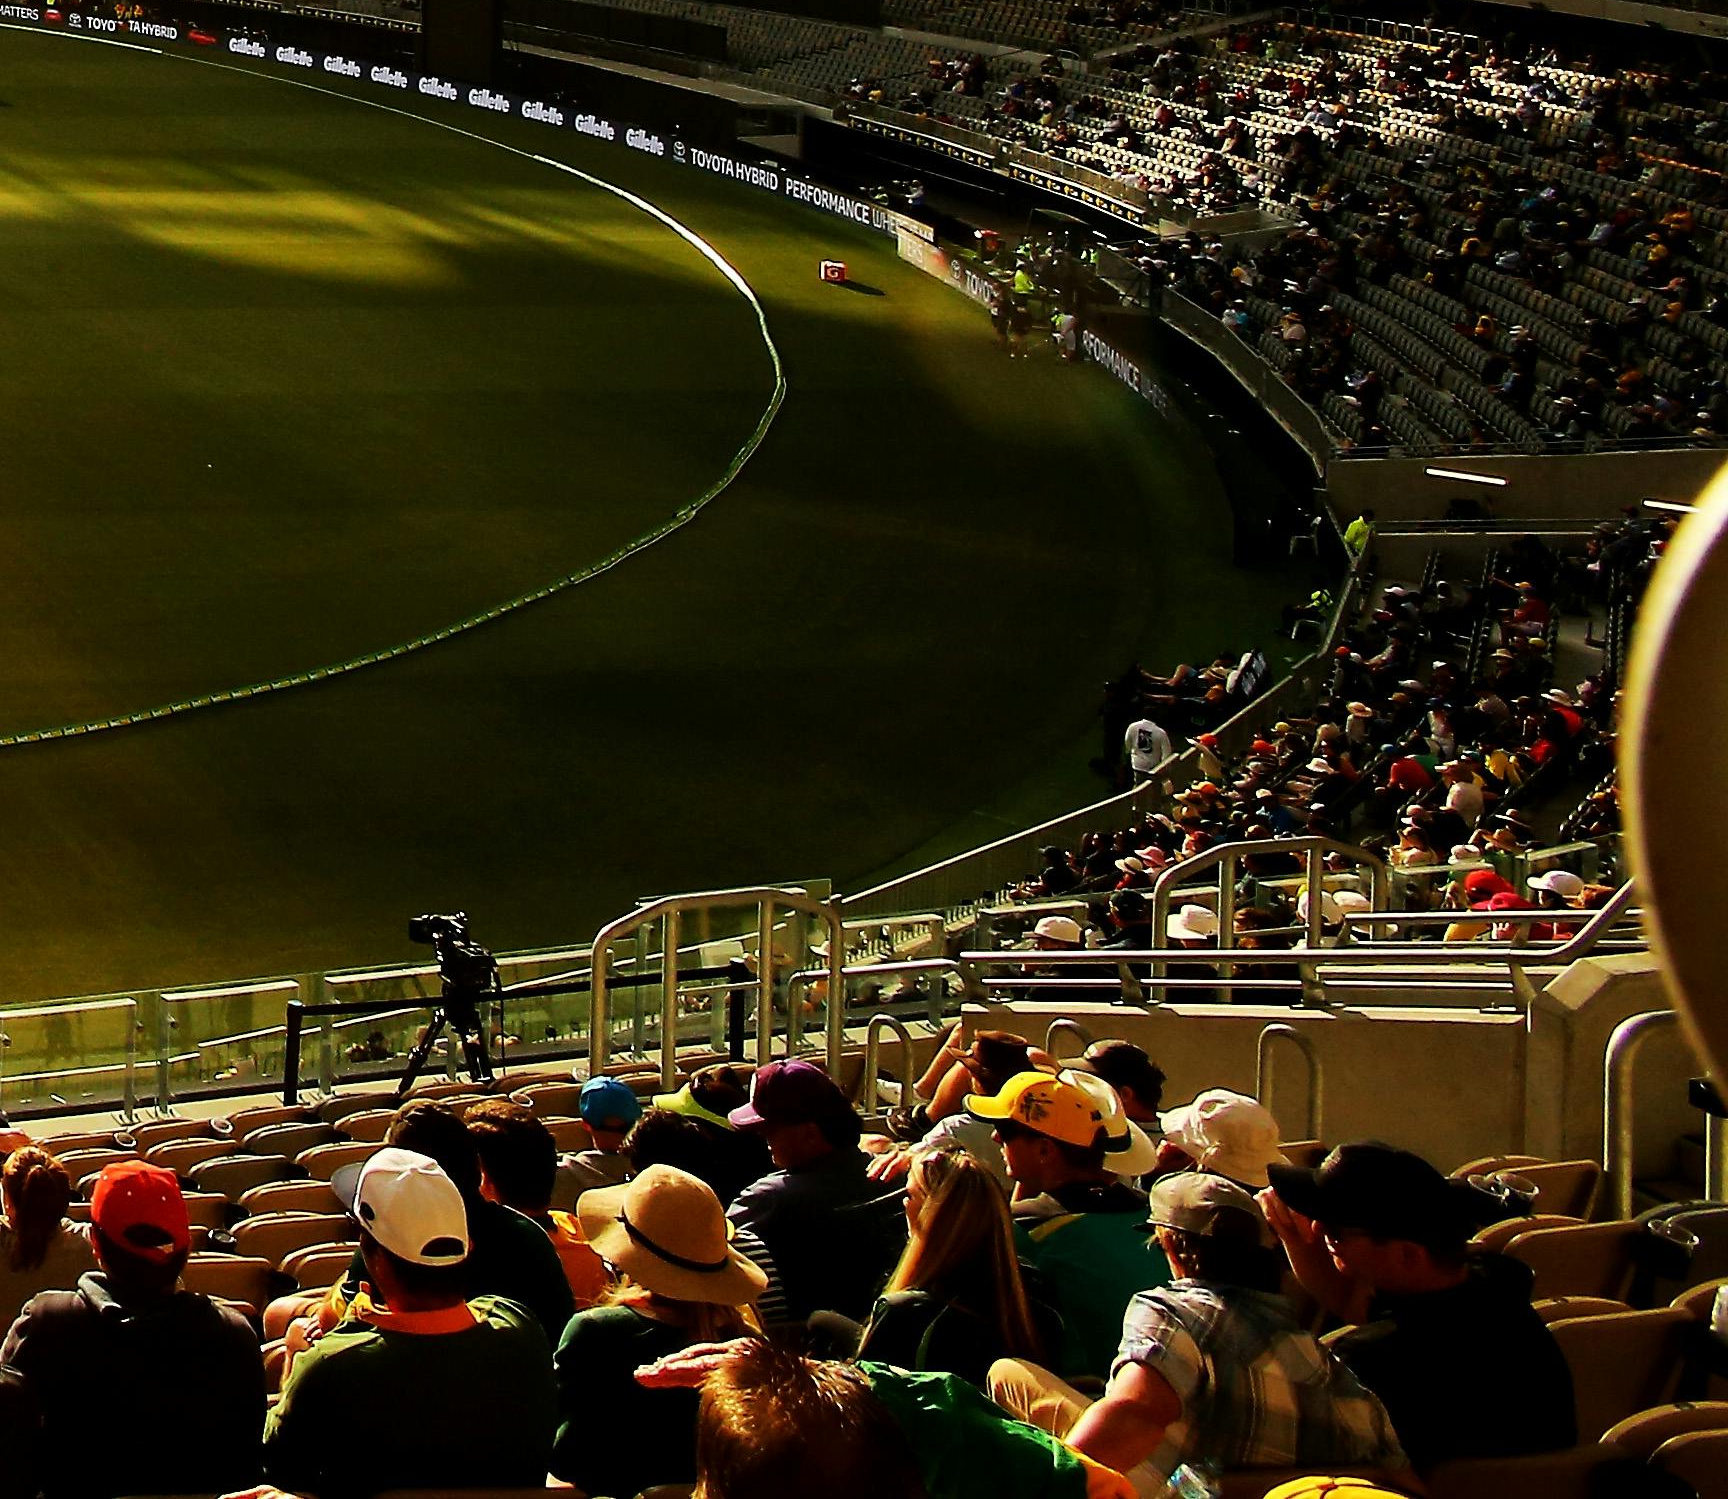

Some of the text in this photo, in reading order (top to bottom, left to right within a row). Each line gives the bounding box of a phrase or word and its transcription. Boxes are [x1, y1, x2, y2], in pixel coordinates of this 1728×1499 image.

[141, 22, 178, 39] HYBRID
[229, 38, 665, 156] Gillette Gillette Gillette Gillette Gillette Gillette Gillette Gillette Gillette
[691, 148, 871, 226] TOYOTA HYBRID PERFORMANCE
